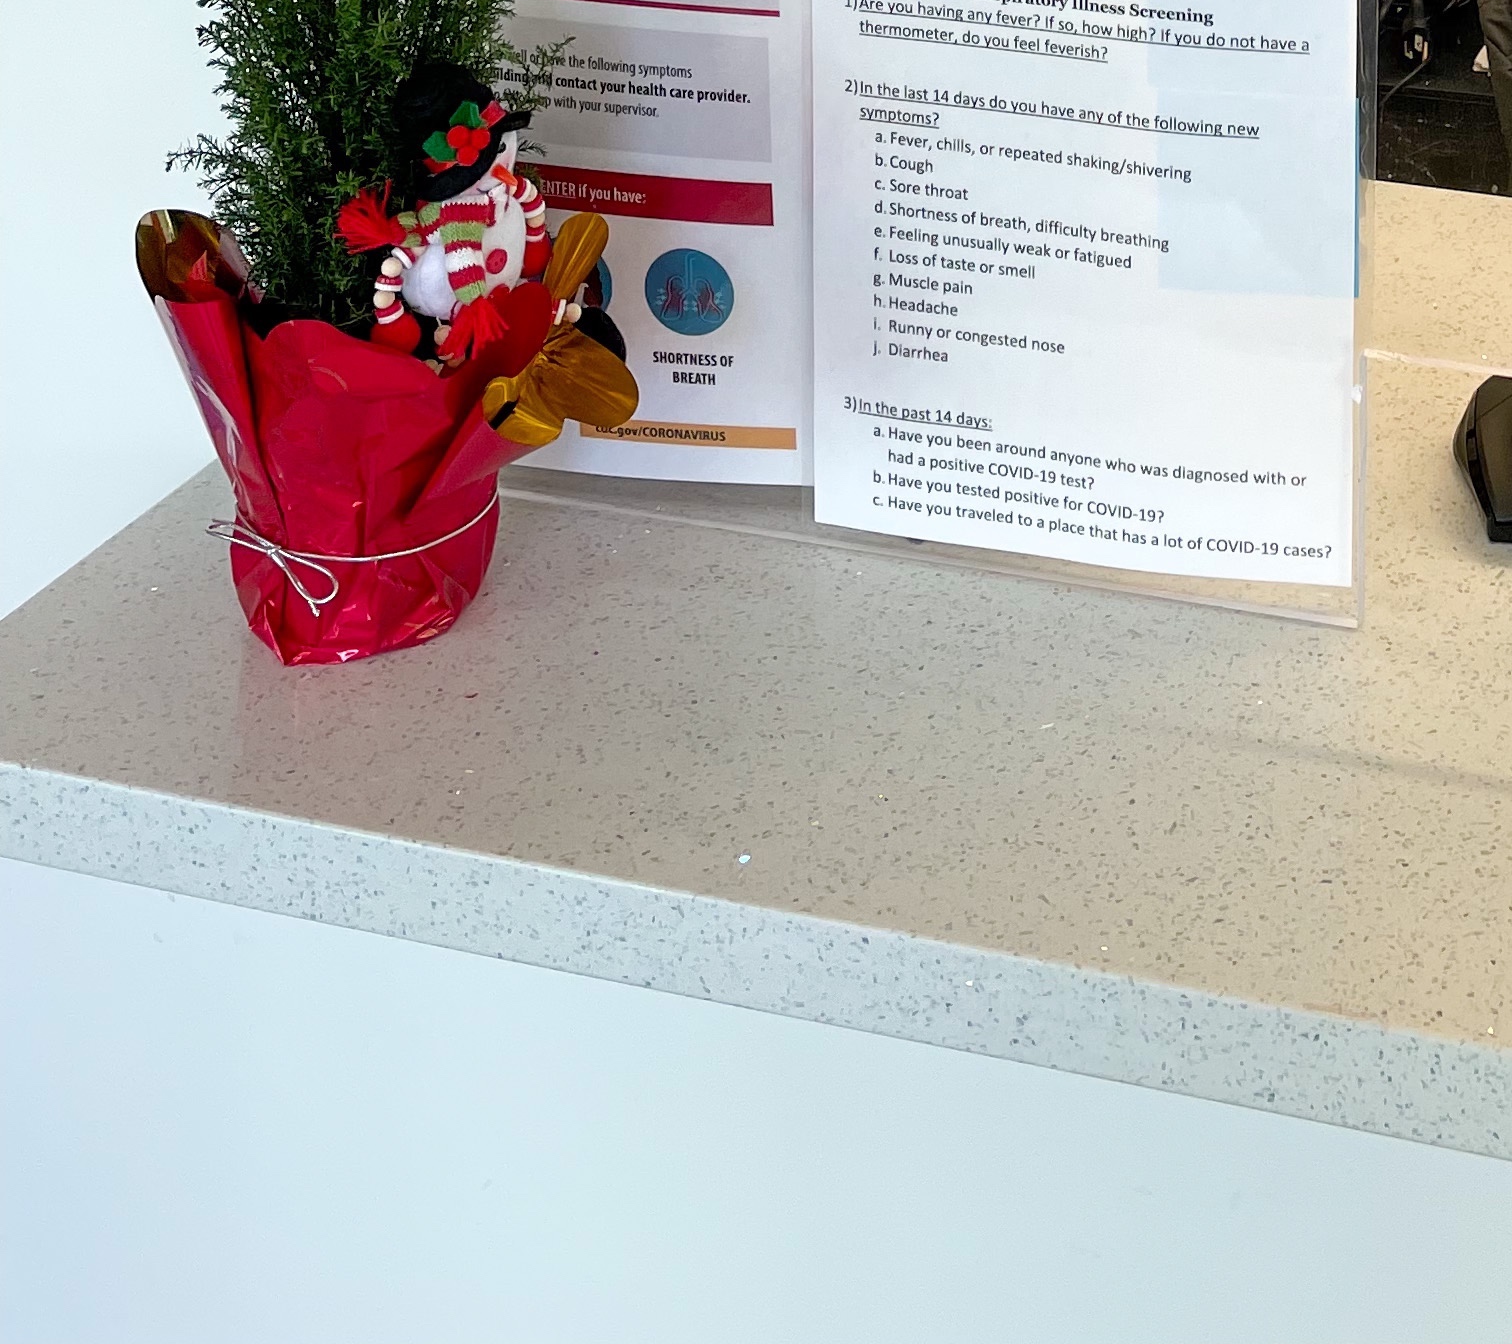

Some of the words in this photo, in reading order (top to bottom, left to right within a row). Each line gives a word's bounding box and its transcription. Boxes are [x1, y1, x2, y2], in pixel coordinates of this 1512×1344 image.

[1129, 4, 1214, 26] Screening
[859, 20, 958, 45] thermometer,
[963, 31, 980, 45] do
[984, 35, 1009, 48] you
[1014, 35, 1040, 52] feel
[1044, 39, 1108, 61] feverish?
[569, 56, 585, 69] the
[588, 56, 636, 76] following
[638, 62, 692, 79] symptoms
[555, 76, 597, 90] contact
[600, 78, 626, 94] your
[629, 79, 667, 97] health
[669, 85, 695, 100] care
[697, 85, 751, 104] provider.
[554, 96, 577, 110] with
[579, 100, 601, 114] your
[604, 102, 659, 118] supervisor.
[860, 106, 939, 127] symptoms?
[875, 132, 886, 144] a.
[890, 132, 932, 151] Fever,
[937, 137, 975, 156] chills,
[980, 143, 995, 156] or
[999, 145, 1062, 165] repeated
[1067, 153, 1192, 183] shaking/shivering
[875, 153, 887, 167] b.
[890, 155, 933, 174] Cough
[578, 183, 587, 197] if
[590, 186, 610, 202] you
[614, 187, 646, 204] have:
[874, 180, 886, 191] c.
[889, 178, 921, 195] Sore
[925, 183, 969, 201] throat
[873, 274, 886, 287] g.
[889, 274, 939, 292] Muscle
[943, 280, 973, 295] pain
[873, 294, 886, 308] h.
[889, 296, 958, 316] Headache
[653, 351, 717, 366] SHORTNESS
[720, 355, 734, 368] OF
[872, 340, 881, 357] j.
[889, 342, 949, 363] Diarrhea
[672, 371, 716, 385] BREATH
[888, 449, 913, 465] had
[918, 456, 925, 467] a
[930, 457, 984, 474] positive
[988, 463, 1056, 484] COVID-19
[1061, 470, 1095, 490] test?
